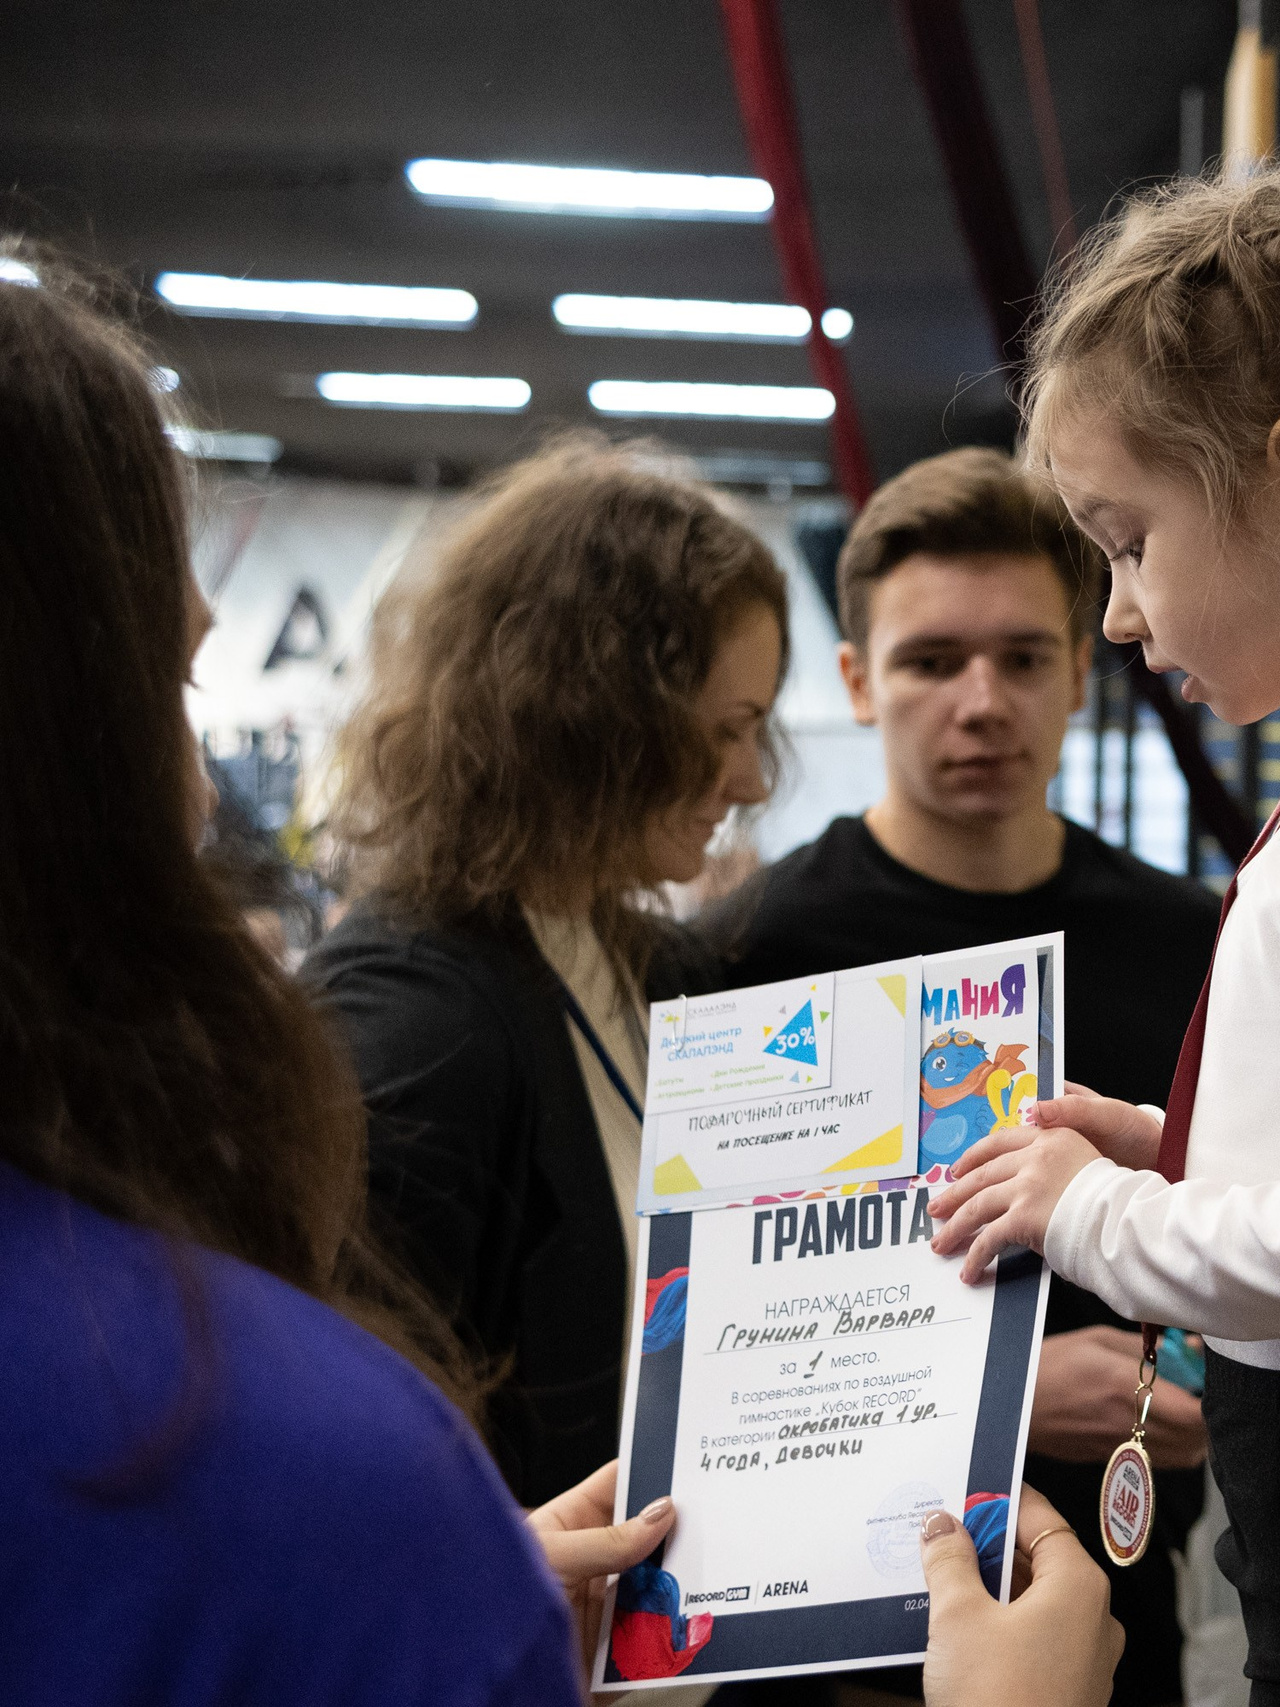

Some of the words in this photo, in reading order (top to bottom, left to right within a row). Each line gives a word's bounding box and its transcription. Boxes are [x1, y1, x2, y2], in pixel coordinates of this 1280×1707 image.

[708, 1026, 743, 1042] центр
[775, 1025, 815, 1054] 30%
[689, 1101, 782, 1132] ПОДАРОЧНЫЙ
[787, 1090, 873, 1116] СЕРТИФИКАТ
[717, 1140, 730, 1151] НА
[733, 1130, 795, 1149] ПОСЕЩЕНИЕ
[799, 1128, 810, 1140] НА
[821, 1124, 841, 1135] ЧАС
[752, 1187, 934, 1265] ГРАМОТА
[764, 1284, 911, 1320] НАГРАЖДАЕТСЯ
[779, 1362, 797, 1376] за
[804, 1350, 824, 1378] 1
[830, 1350, 881, 1369] место.
[731, 1391, 739, 1405] В
[742, 1383, 841, 1406] соревнованиях
[844, 1379, 860, 1391] по
[863, 1366, 932, 1388] воздушной
[739, 1406, 812, 1426] гимнастике
[700, 1436, 709, 1449] В
[711, 1430, 776, 1449] категории
[700, 1453, 711, 1472] 4
[688, 1591, 726, 1604] RECORD
[763, 1579, 809, 1598] ARENA
